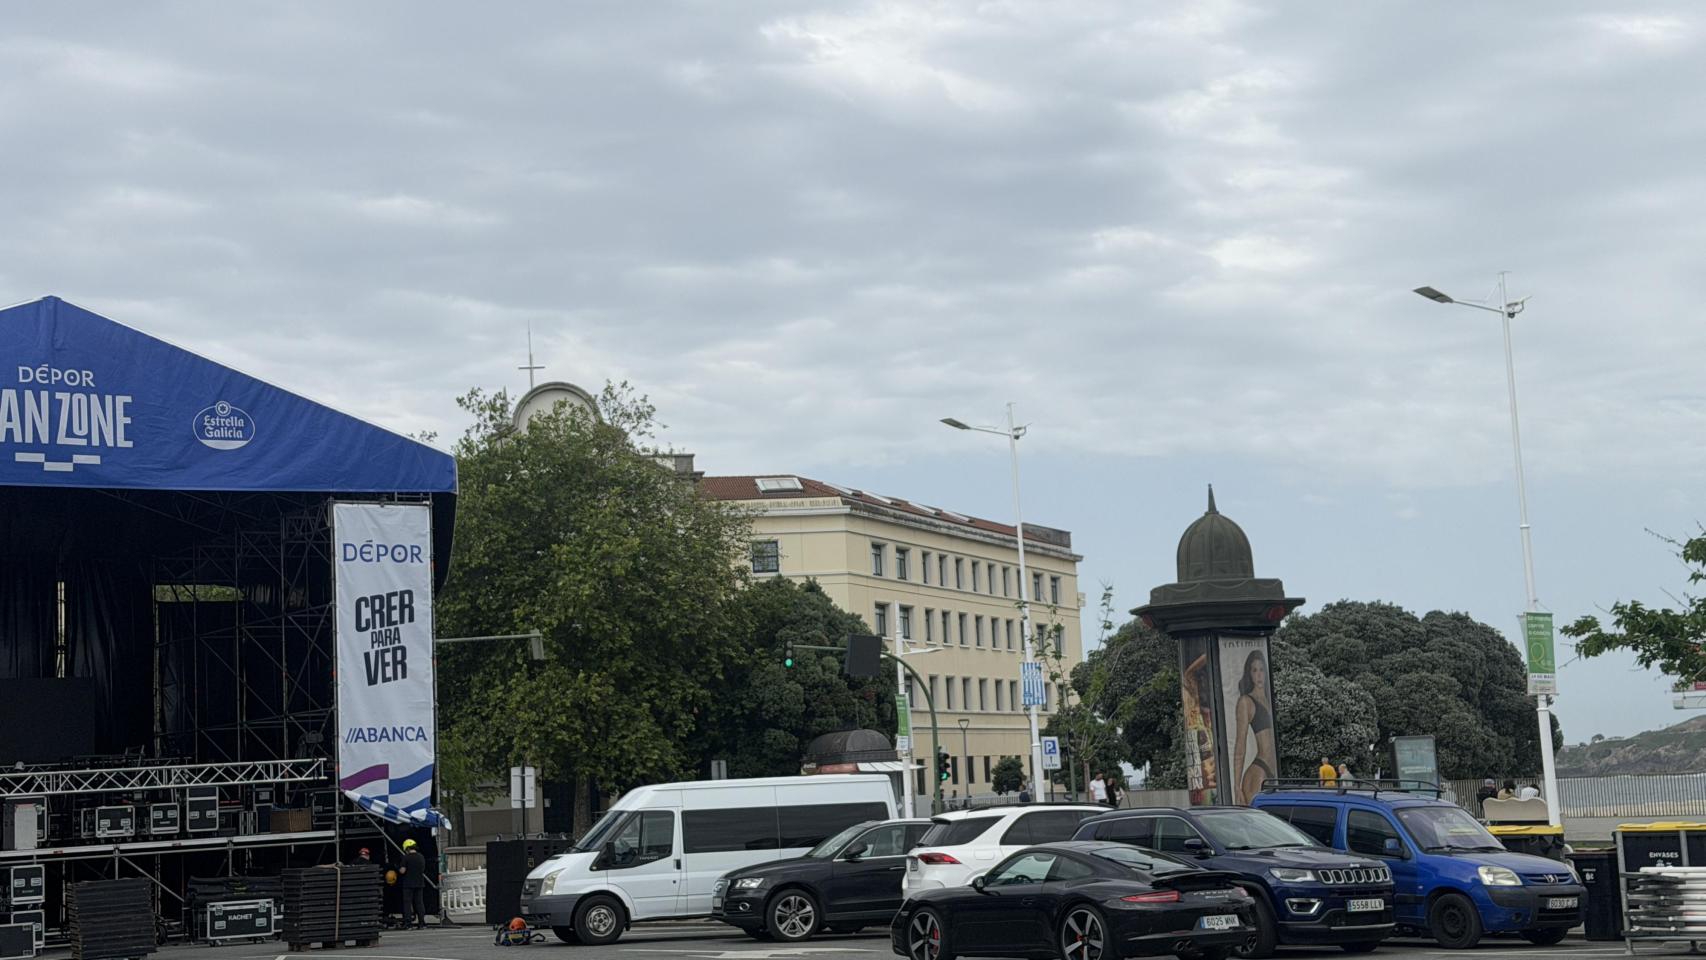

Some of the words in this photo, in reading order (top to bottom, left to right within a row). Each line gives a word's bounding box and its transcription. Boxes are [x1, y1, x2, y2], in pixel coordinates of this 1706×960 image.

[18, 364, 95, 387] DÉPOR
[203, 414, 245, 428] Estrella
[204, 426, 243, 439] Galicia
[342, 539, 424, 564] DÉPOR
[354, 589, 415, 633] CRER
[370, 625, 402, 649] PARA
[363, 644, 408, 687] VER
